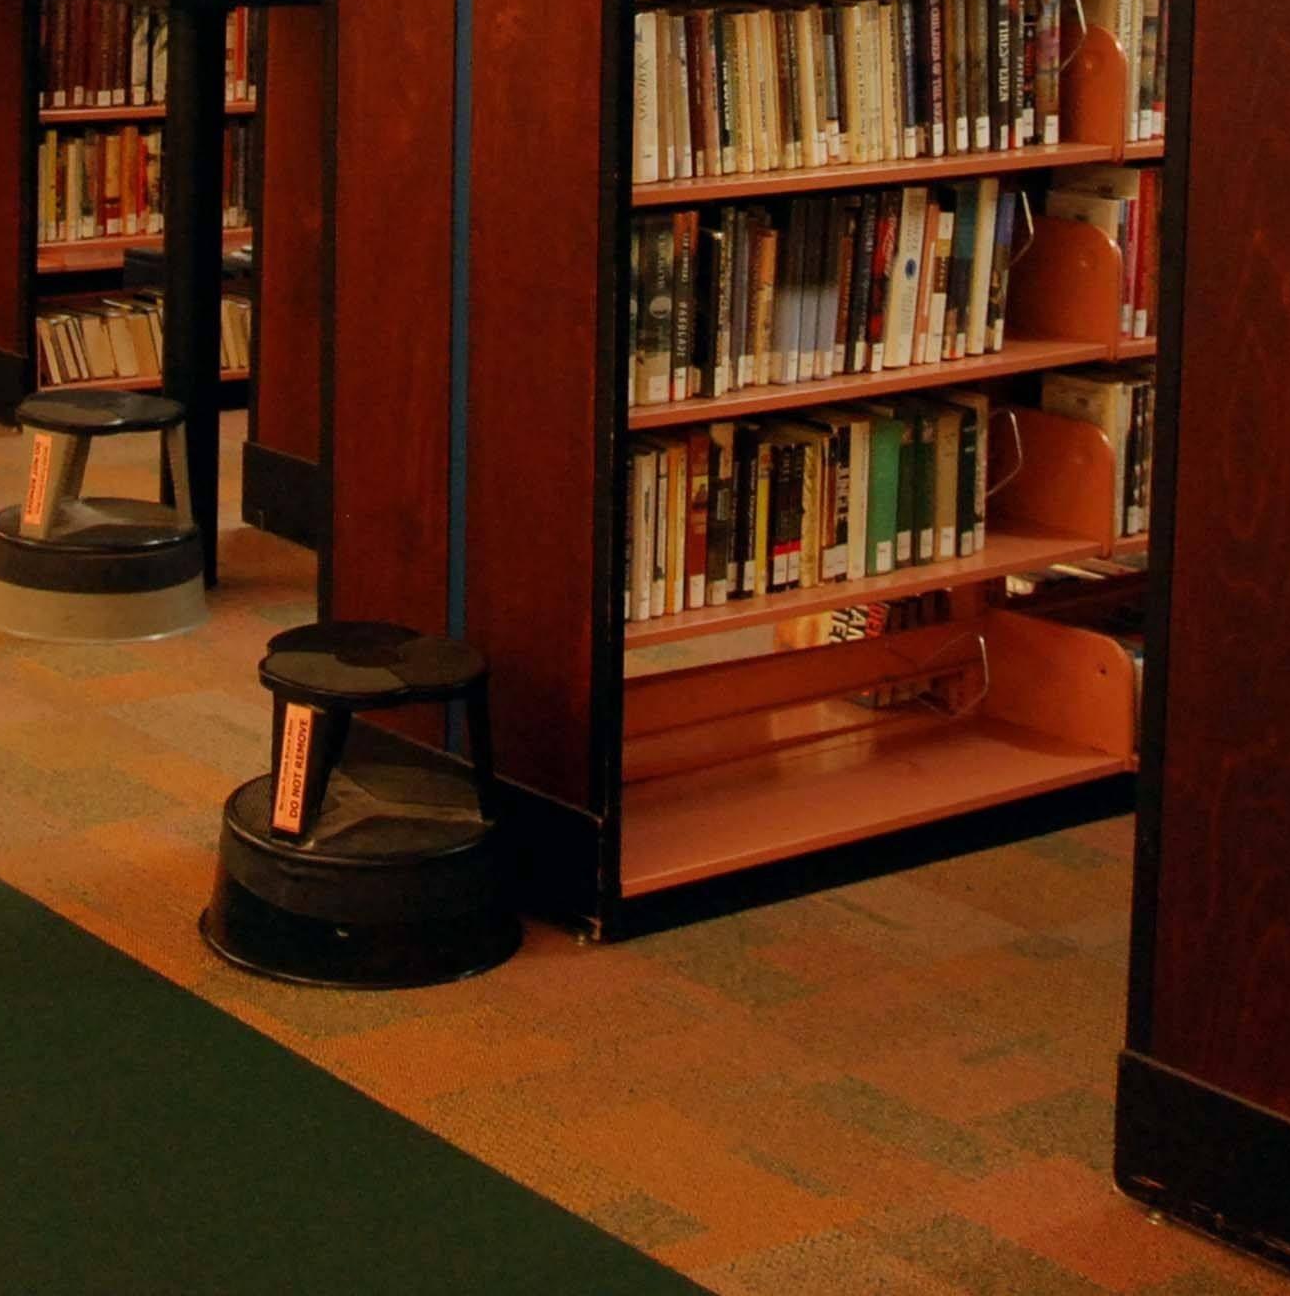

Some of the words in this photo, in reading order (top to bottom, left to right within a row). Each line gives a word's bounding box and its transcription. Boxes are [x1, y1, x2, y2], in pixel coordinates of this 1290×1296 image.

[294, 718, 308, 769] REMOVE
[291, 771, 302, 798] NOT
[288, 799, 299, 819] DO
